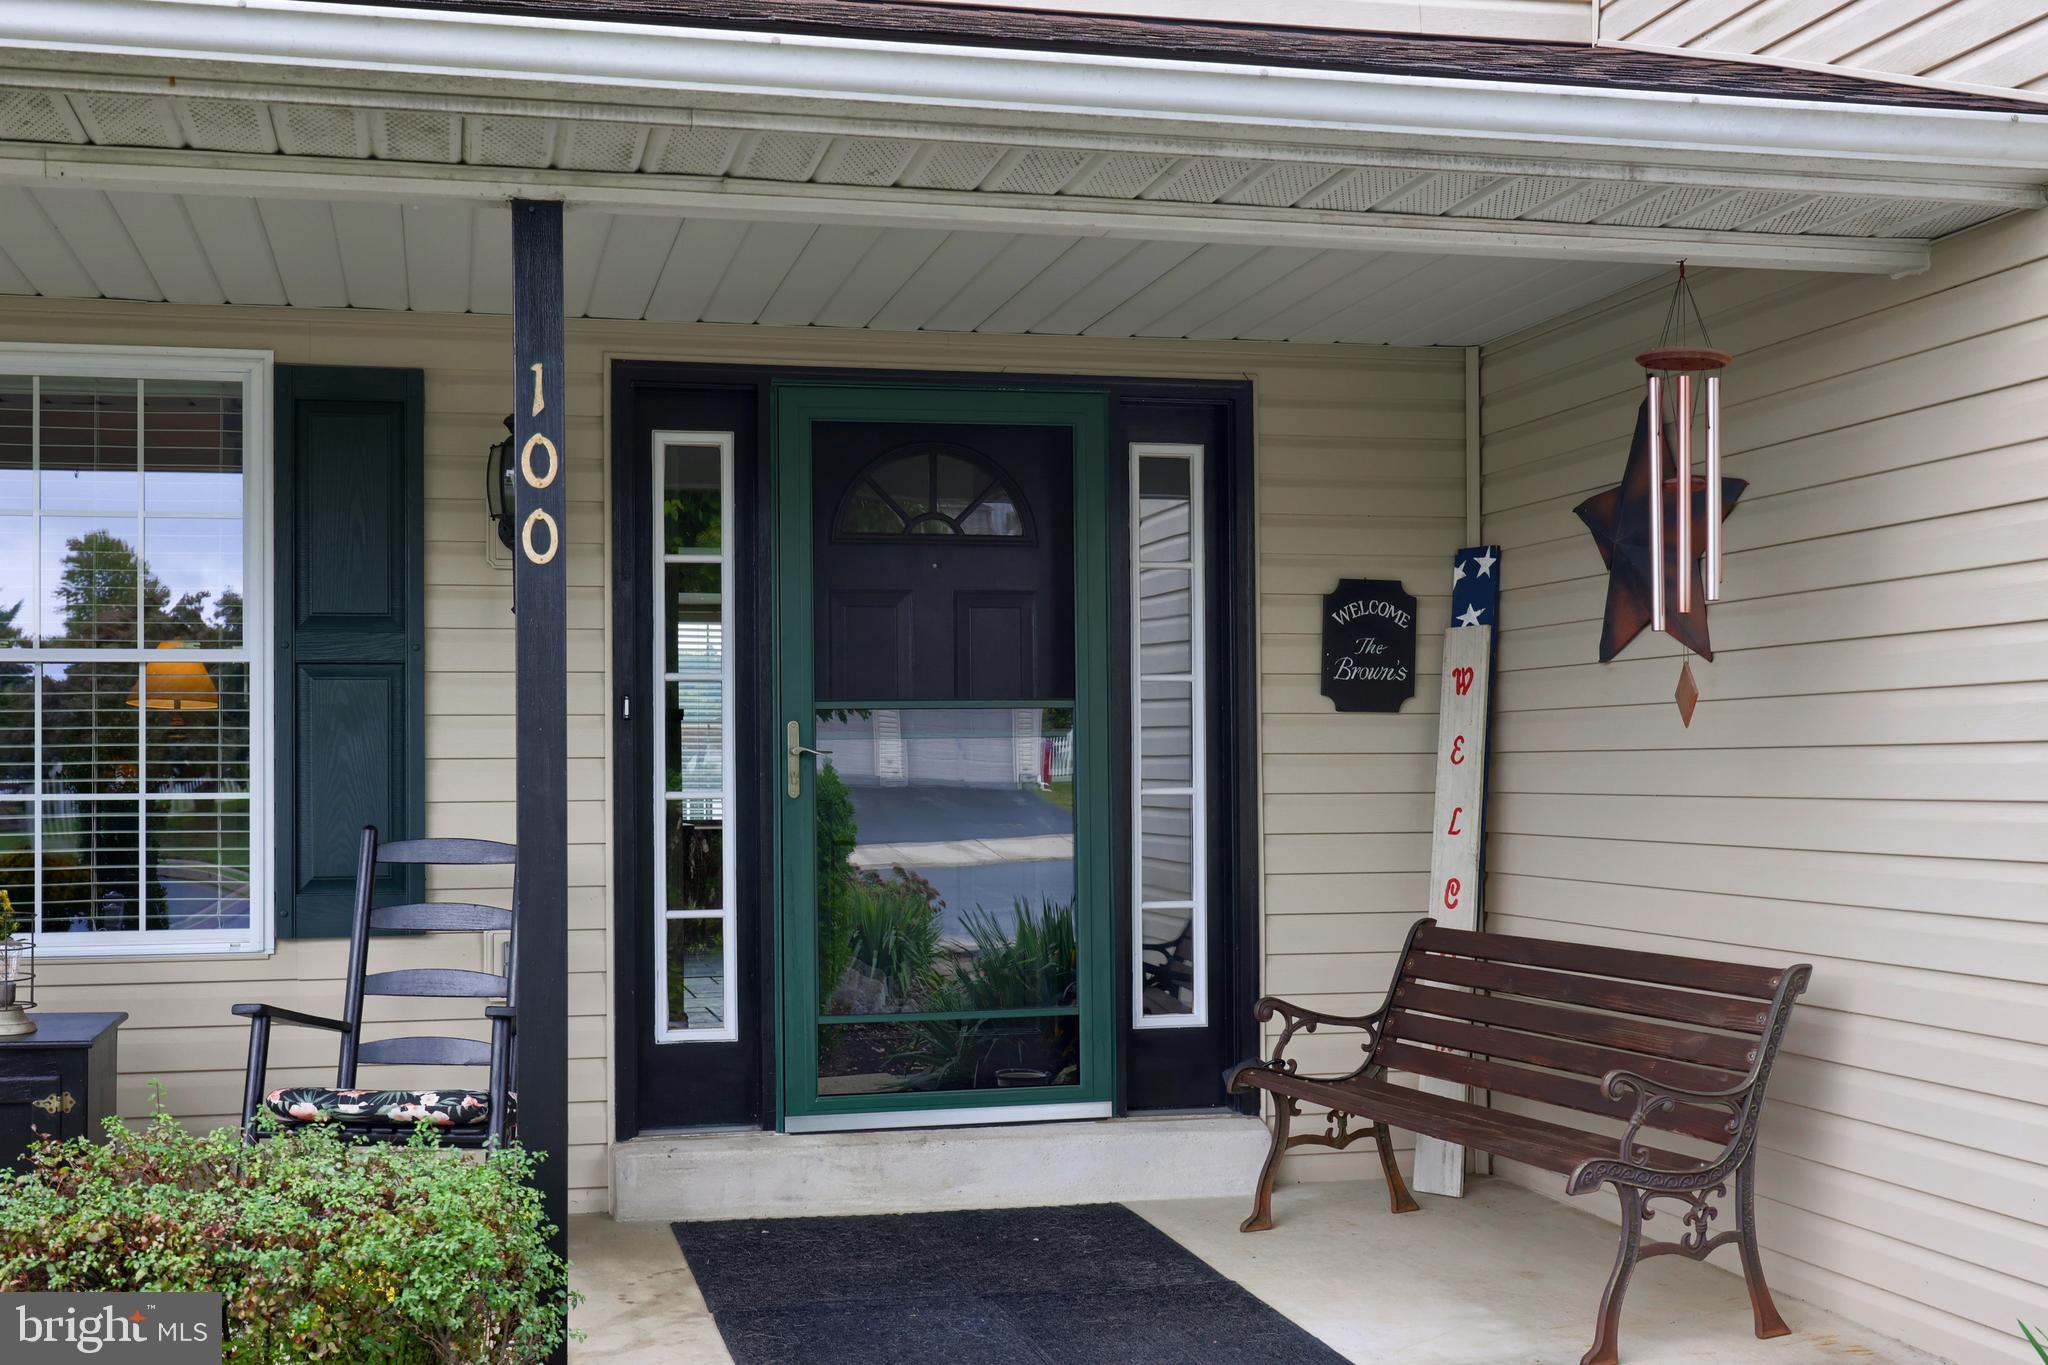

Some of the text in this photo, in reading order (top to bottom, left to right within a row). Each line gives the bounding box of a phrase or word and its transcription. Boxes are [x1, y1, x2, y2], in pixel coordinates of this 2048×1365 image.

[521, 363, 559, 565] 100
[1332, 600, 1411, 629] WELCOME
[1355, 637, 1388, 655] The
[1333, 656, 1408, 681] Brown's
